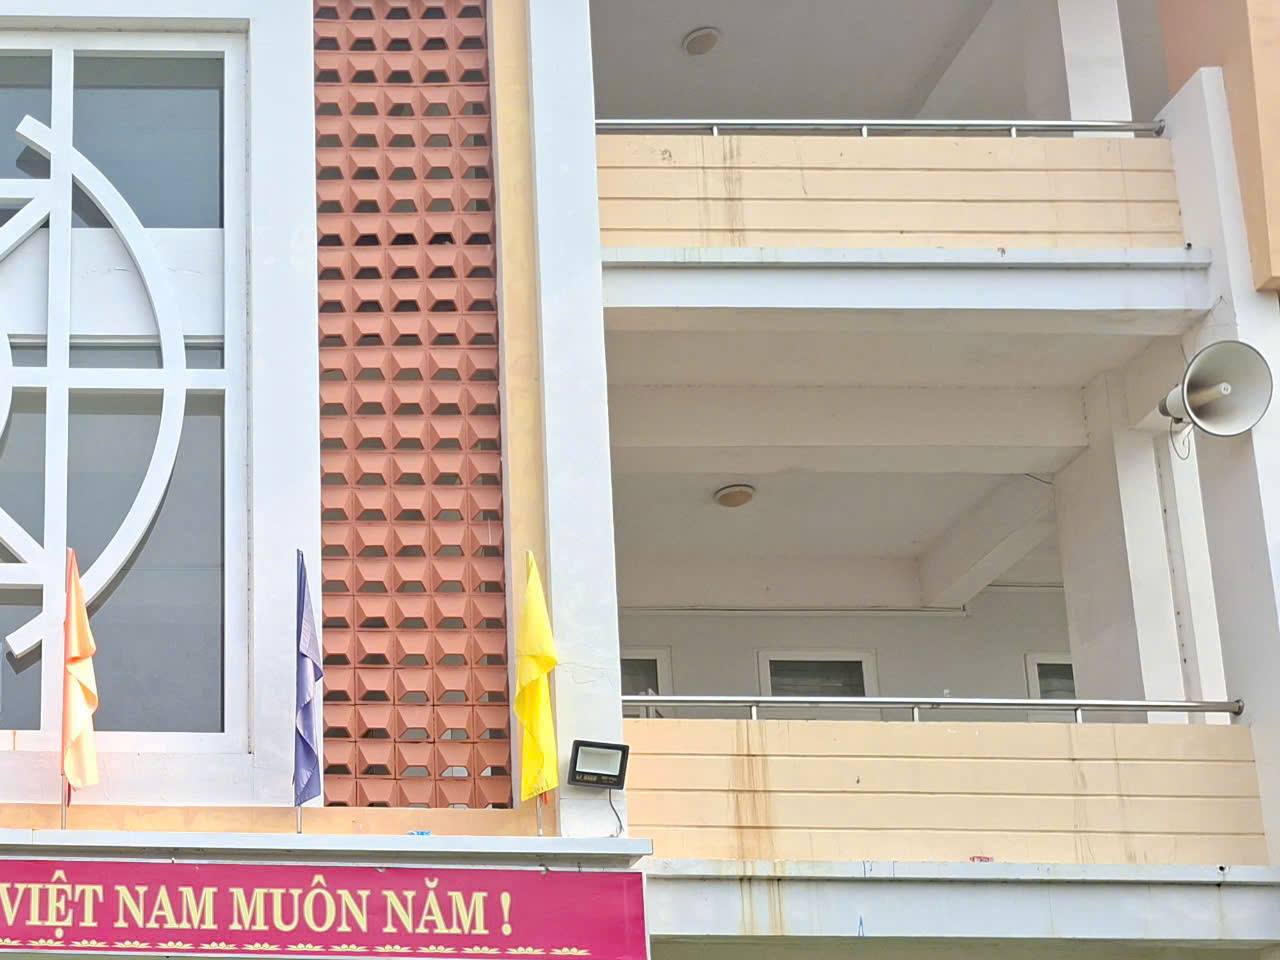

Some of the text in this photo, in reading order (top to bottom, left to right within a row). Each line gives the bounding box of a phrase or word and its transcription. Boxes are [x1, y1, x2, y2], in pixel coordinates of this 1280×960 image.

[113, 885, 218, 929] NAM
[229, 874, 370, 933] MUÔN
[382, 877, 489, 935] NĂM
[499, 891, 513, 936] !
